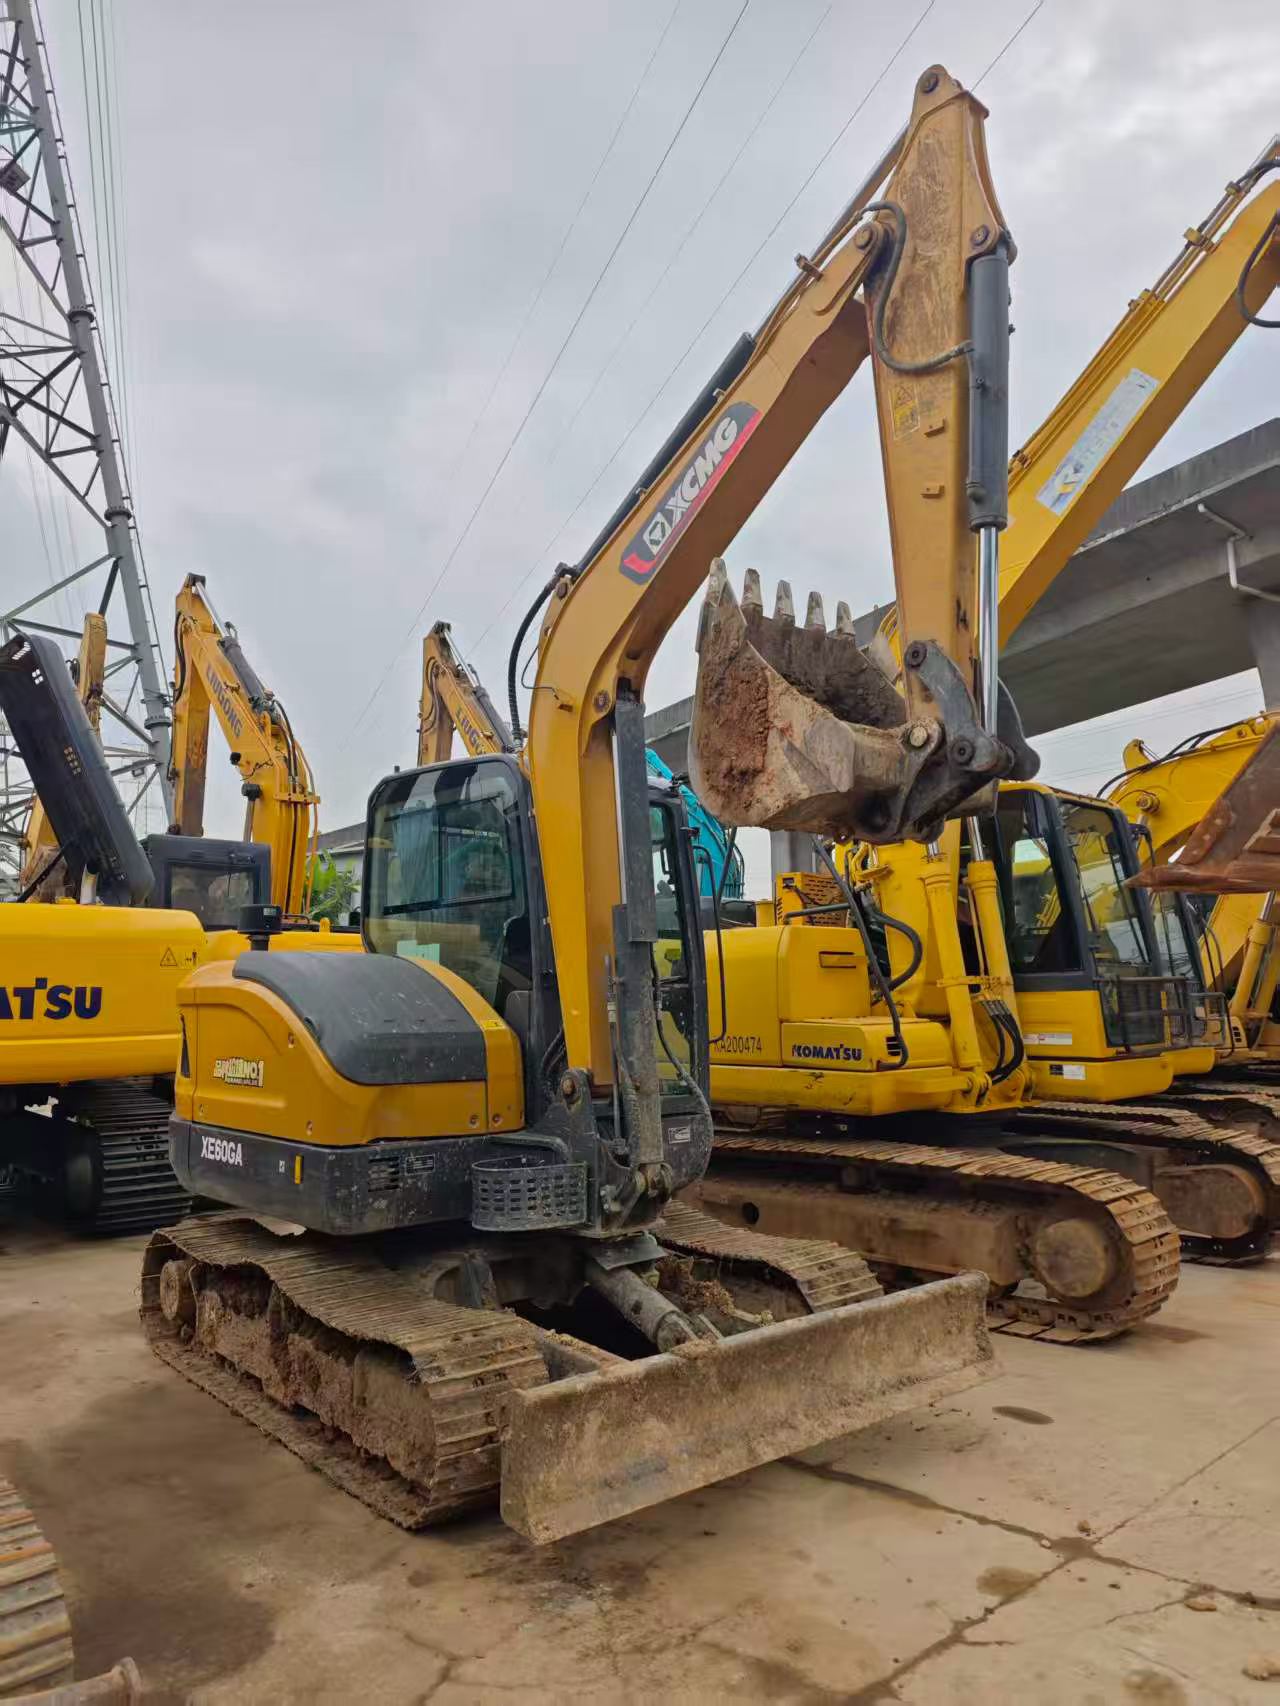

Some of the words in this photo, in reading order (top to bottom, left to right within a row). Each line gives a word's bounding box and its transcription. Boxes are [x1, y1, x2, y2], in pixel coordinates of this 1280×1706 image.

[665, 416, 738, 529] XCMG
[206, 664, 243, 737] LIUGONG
[791, 1043, 863, 1062] KOMATSU
[200, 1135, 243, 1167] XE60GA
